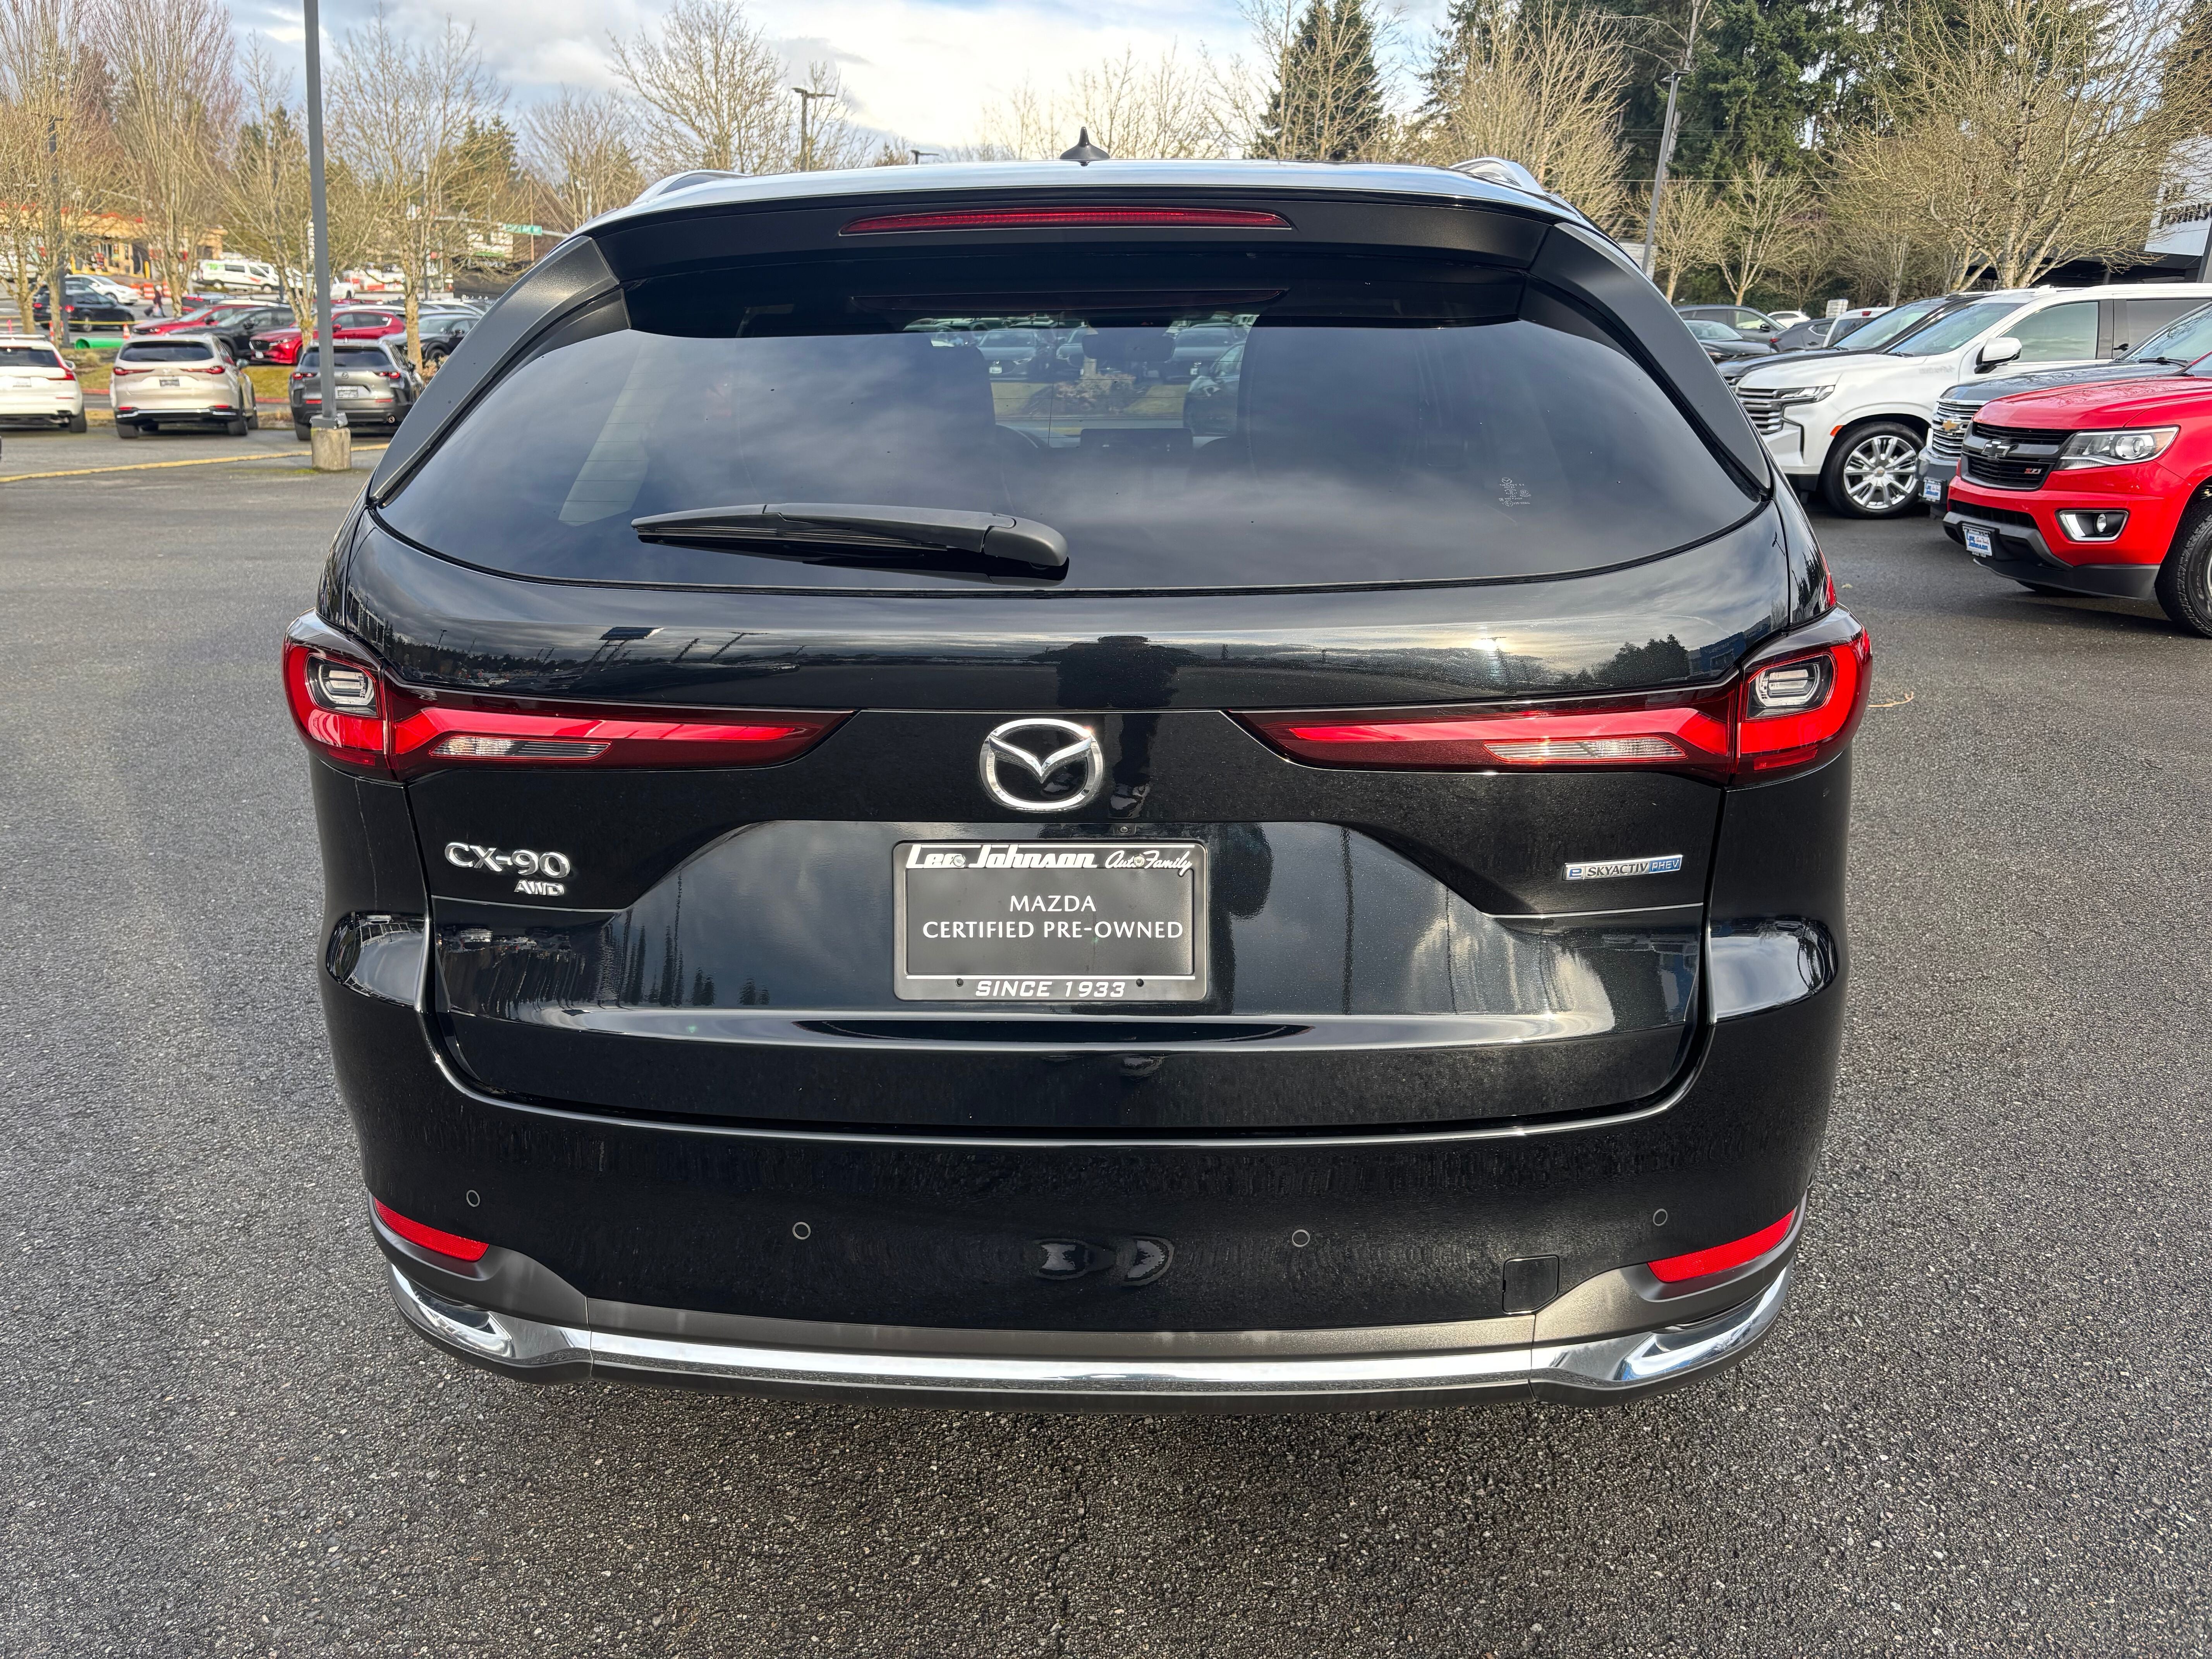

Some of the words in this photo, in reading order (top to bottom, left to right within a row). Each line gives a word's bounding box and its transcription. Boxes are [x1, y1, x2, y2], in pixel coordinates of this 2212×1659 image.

[444, 842, 570, 878] CX-90
[969, 844, 1098, 868] Johnson
[1105, 850, 1145, 869] Aut
[1143, 850, 1193, 876] Family
[1587, 863, 1649, 877] SKYACTIV
[1651, 859, 1680, 871] PHEV
[514, 879, 564, 896] AWD
[1010, 895, 1097, 912] MAZDA
[922, 921, 1035, 939] CERTIFIED
[1044, 921, 1183, 939] PRE-OWNED
[975, 981, 1052, 997] SINCE
[1065, 981, 1126, 998] 1933
